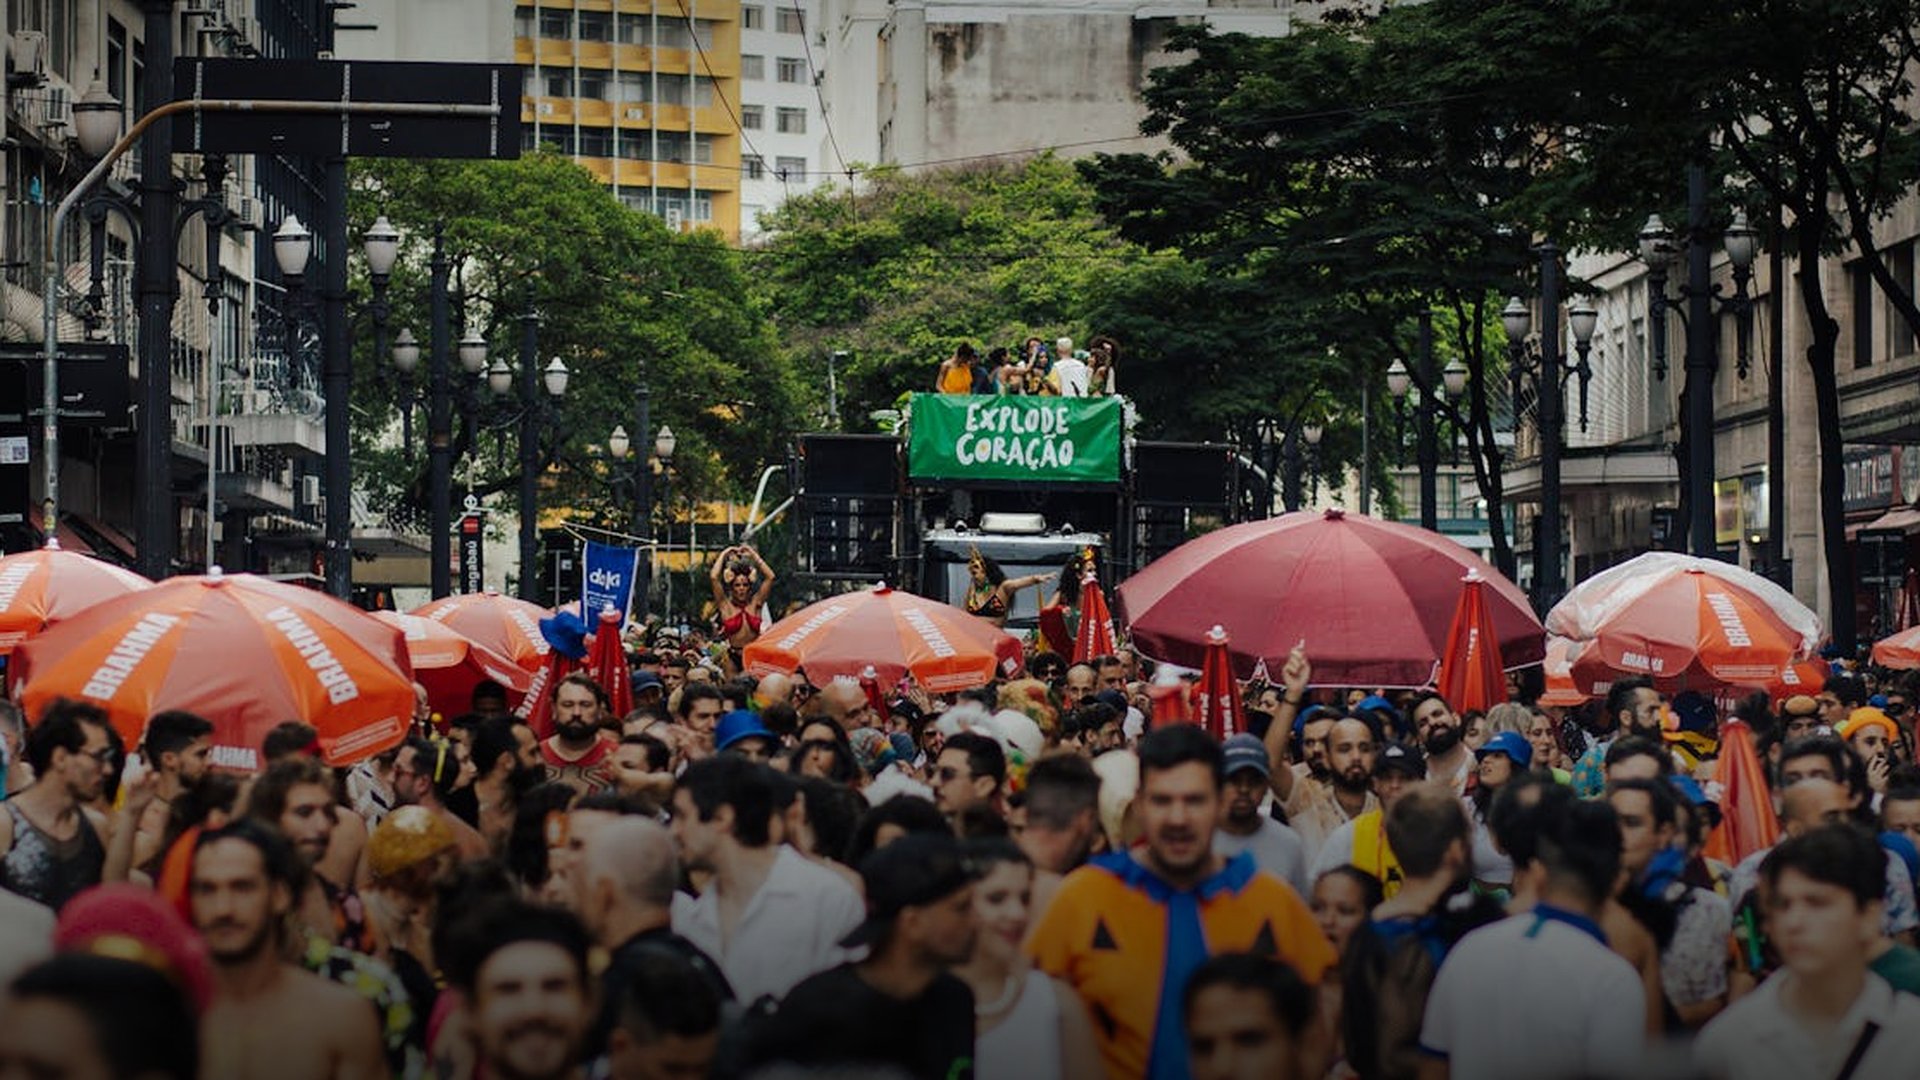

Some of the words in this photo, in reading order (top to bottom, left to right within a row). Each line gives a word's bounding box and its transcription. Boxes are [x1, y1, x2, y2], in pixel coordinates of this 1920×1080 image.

[965, 404, 1070, 435] EXPLODE
[956, 432, 1074, 471] CORAÇÃO
[465, 540, 480, 595] angabaú
[81, 612, 181, 700] BRAHMA
[266, 606, 359, 704] BRAHMA
[208, 744, 257, 769] AHMA
